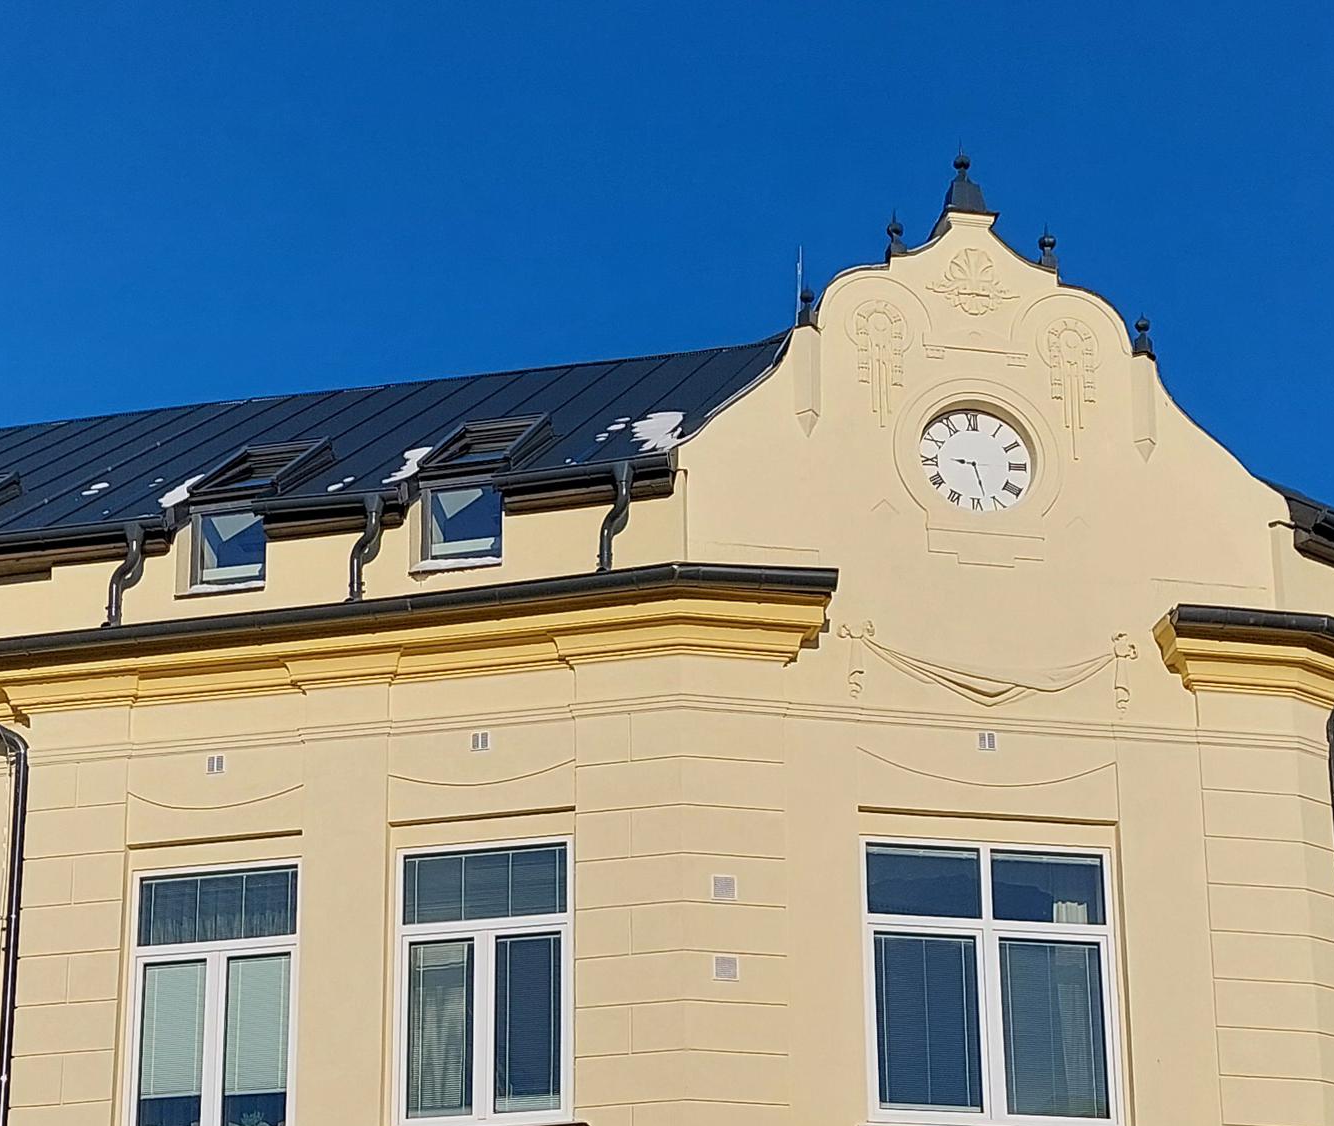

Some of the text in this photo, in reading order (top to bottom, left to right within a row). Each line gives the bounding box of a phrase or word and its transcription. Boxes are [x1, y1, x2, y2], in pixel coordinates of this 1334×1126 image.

[924, 431, 946, 449] X
[1002, 440, 1021, 454] II
[1008, 461, 1027, 473] III
